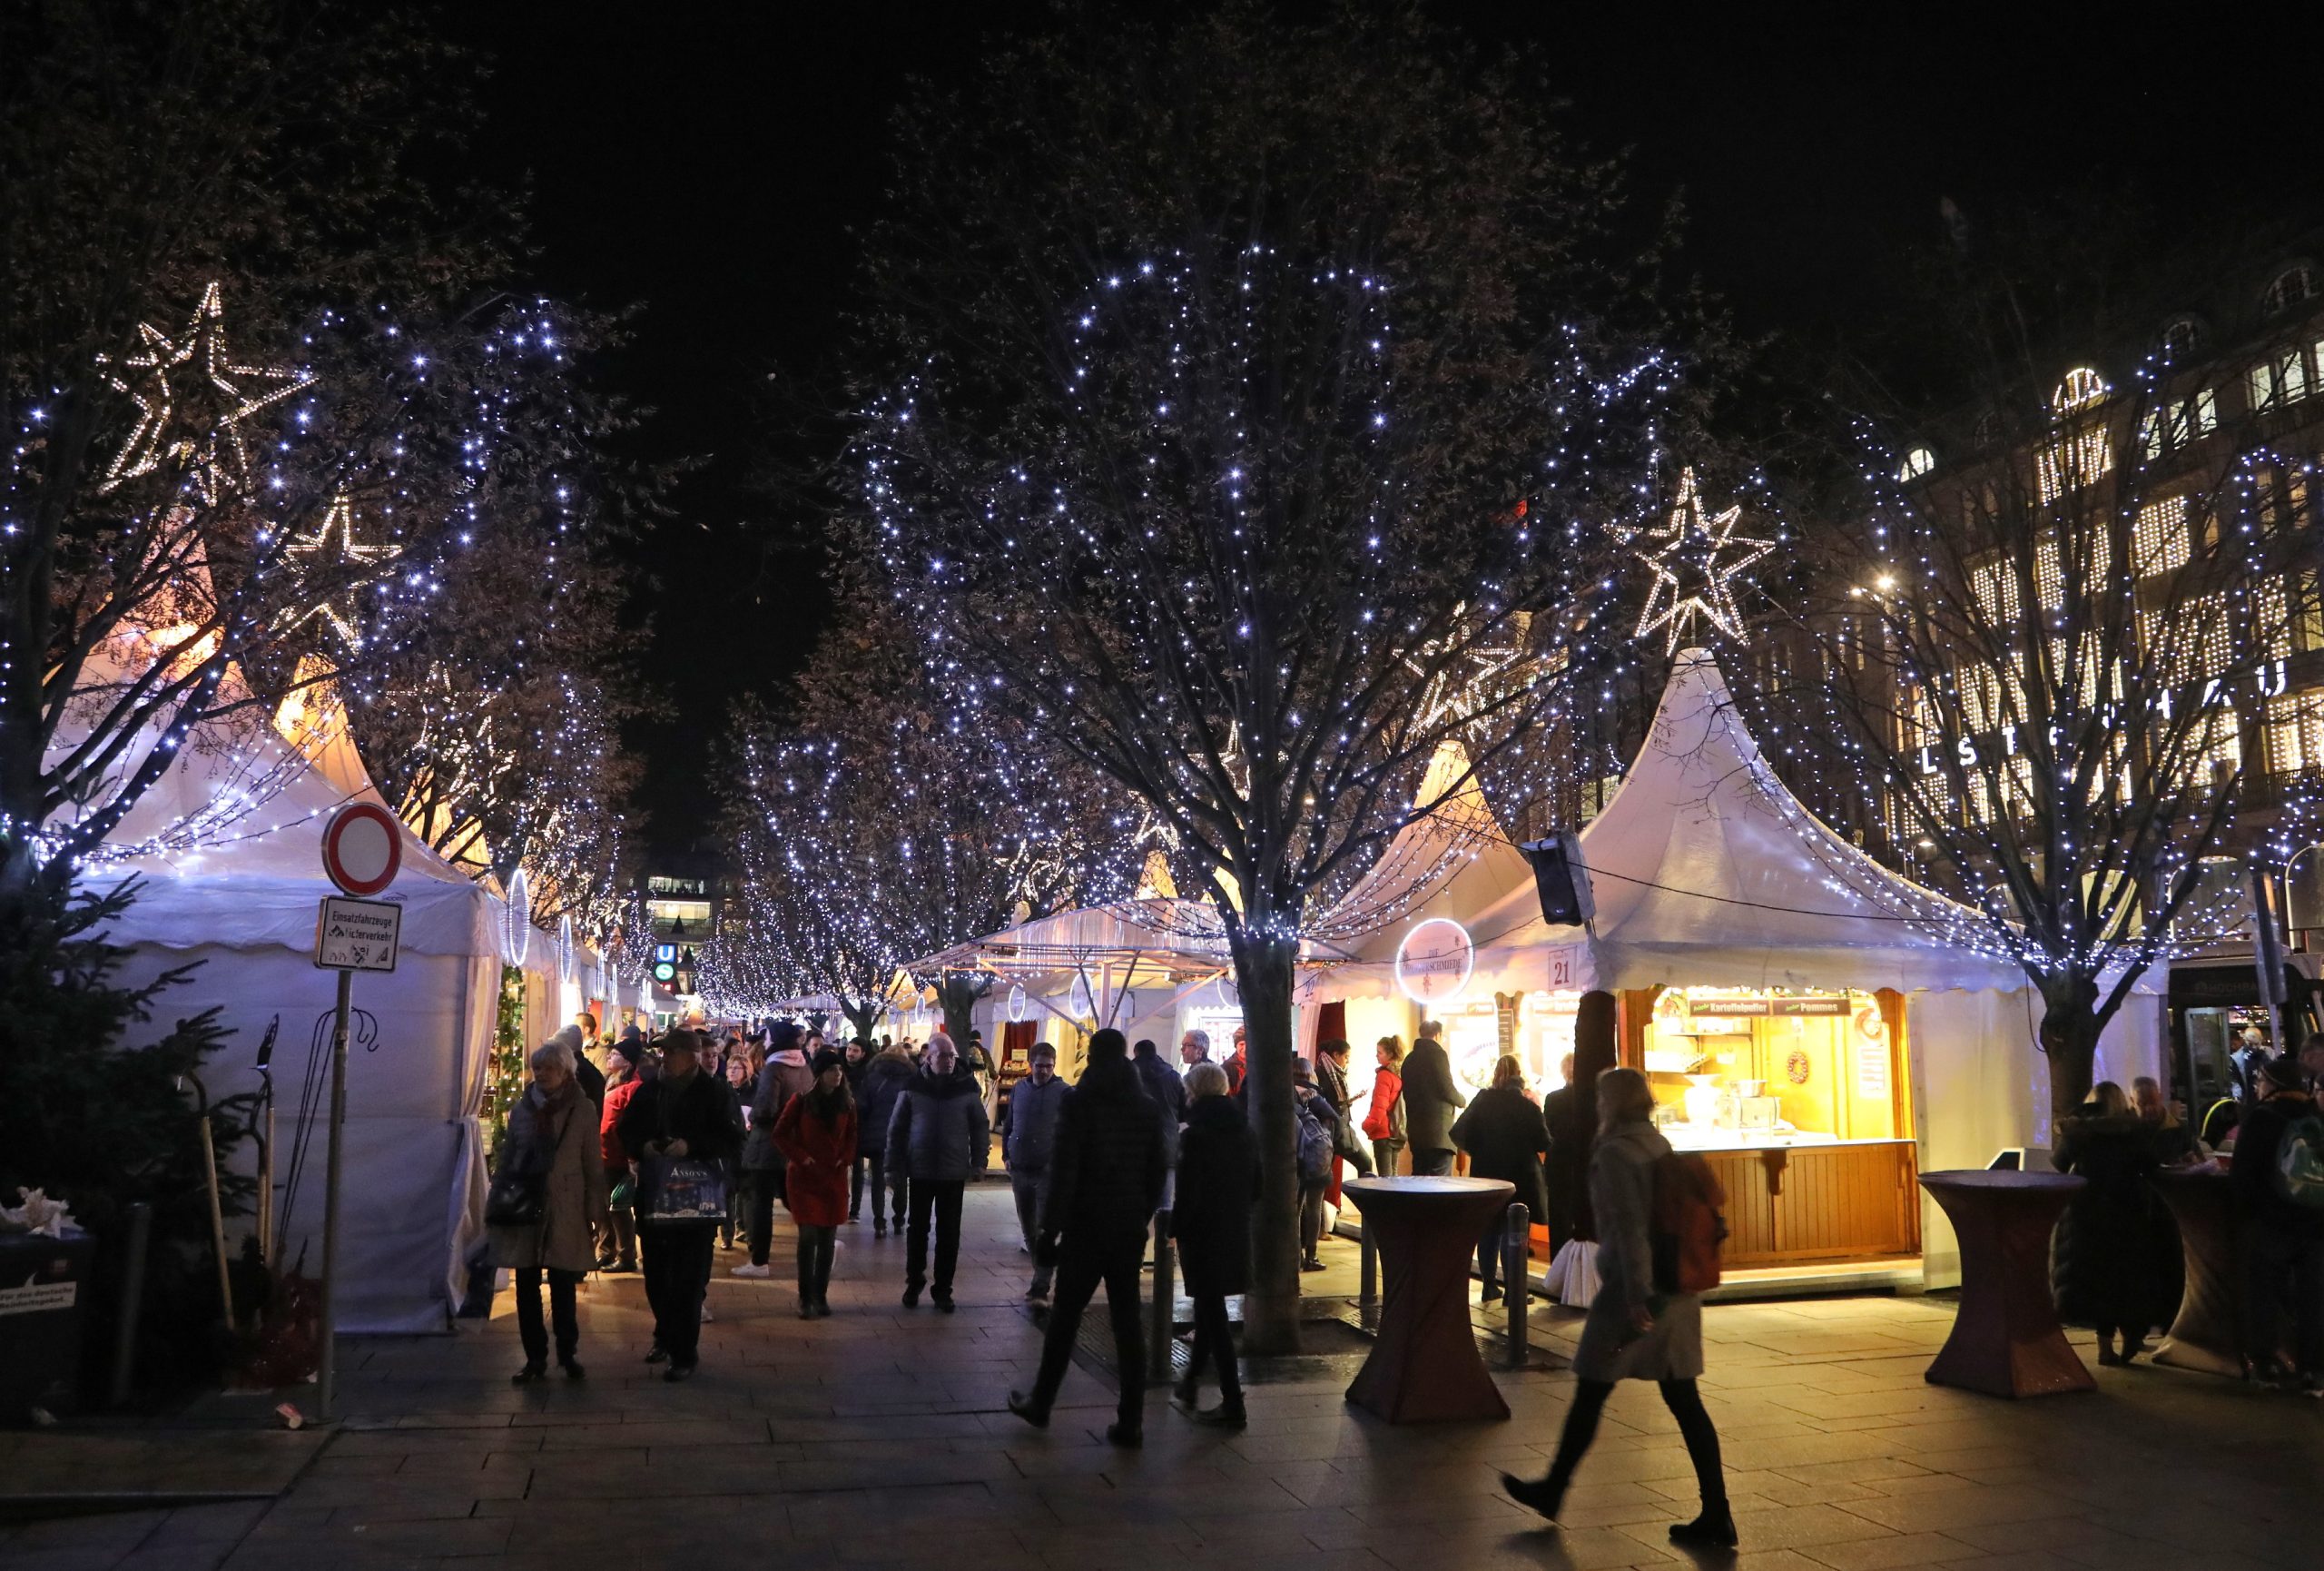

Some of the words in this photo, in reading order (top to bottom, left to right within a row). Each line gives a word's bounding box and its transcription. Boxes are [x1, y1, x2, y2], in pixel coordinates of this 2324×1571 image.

[332, 911, 392, 929] Einsatzfahrzeuge
[658, 945, 673, 961] U
[1429, 948, 1439, 958] DIE
[1554, 961, 1570, 985] 21
[2209, 982, 2259, 993] HOCHBA
[1710, 1003, 1768, 1013] Kartoffelpuffer
[1800, 1003, 1838, 1012] Pommes
